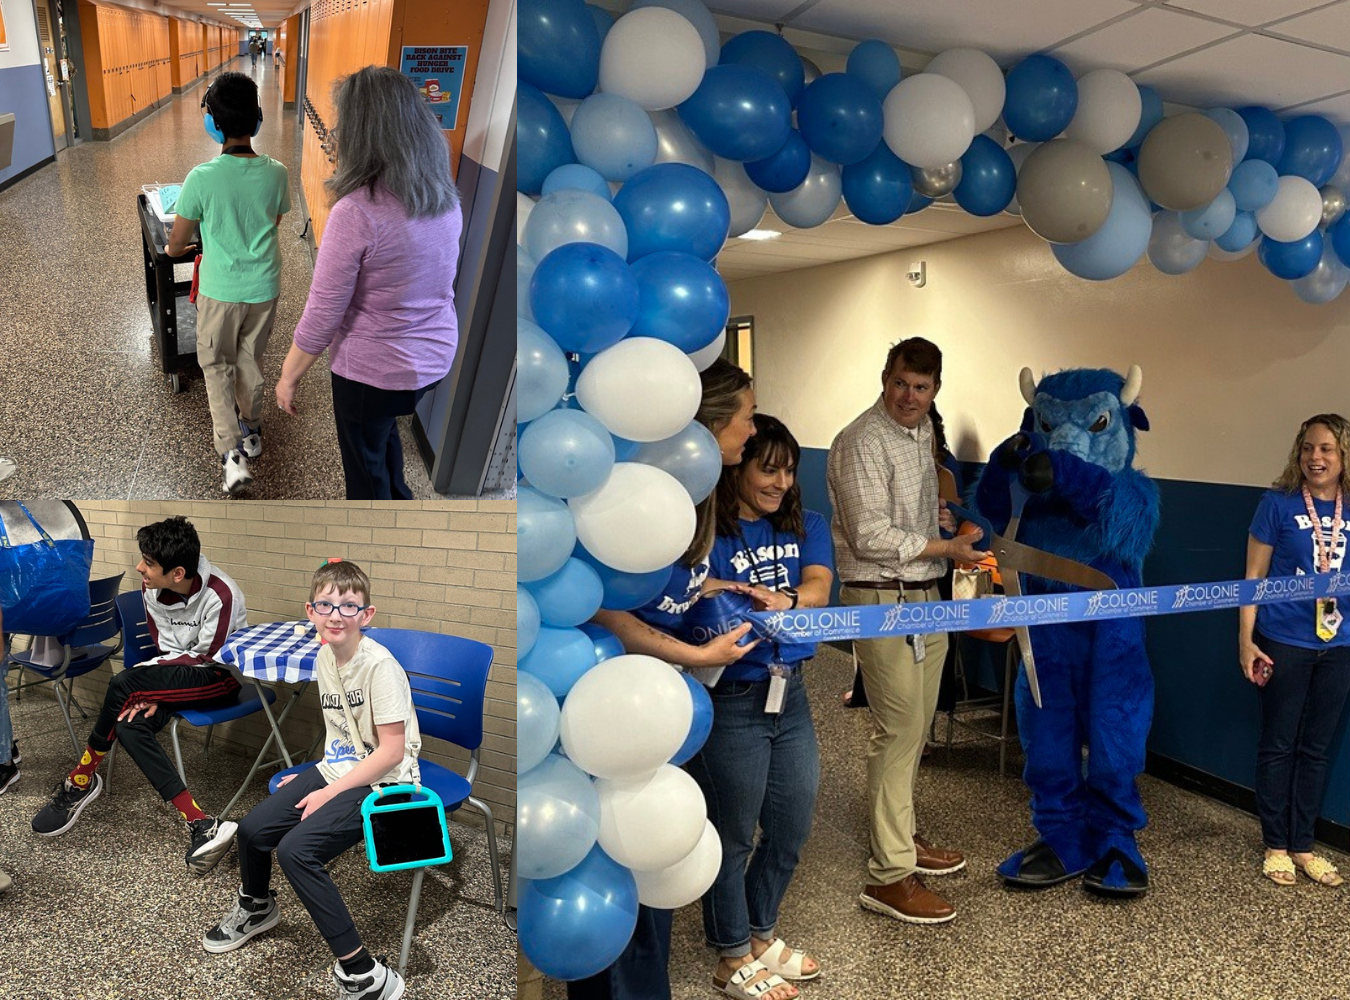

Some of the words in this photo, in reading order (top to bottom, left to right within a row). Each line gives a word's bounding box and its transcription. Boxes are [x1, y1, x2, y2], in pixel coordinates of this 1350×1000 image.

[729, 542, 800, 574] Bison
[1185, 583, 1240, 601] COLONIE
[1265, 577, 1315, 594] COLONIE
[1003, 597, 1069, 616] COLONIE
[1099, 590, 1158, 609] COLONIE
[781, 610, 861, 631] COLONIE
[898, 603, 970, 623] COLONIE
[692, 618, 739, 642] ONIE
[322, 694, 343, 709] NO
[325, 739, 356, 760] Spee
